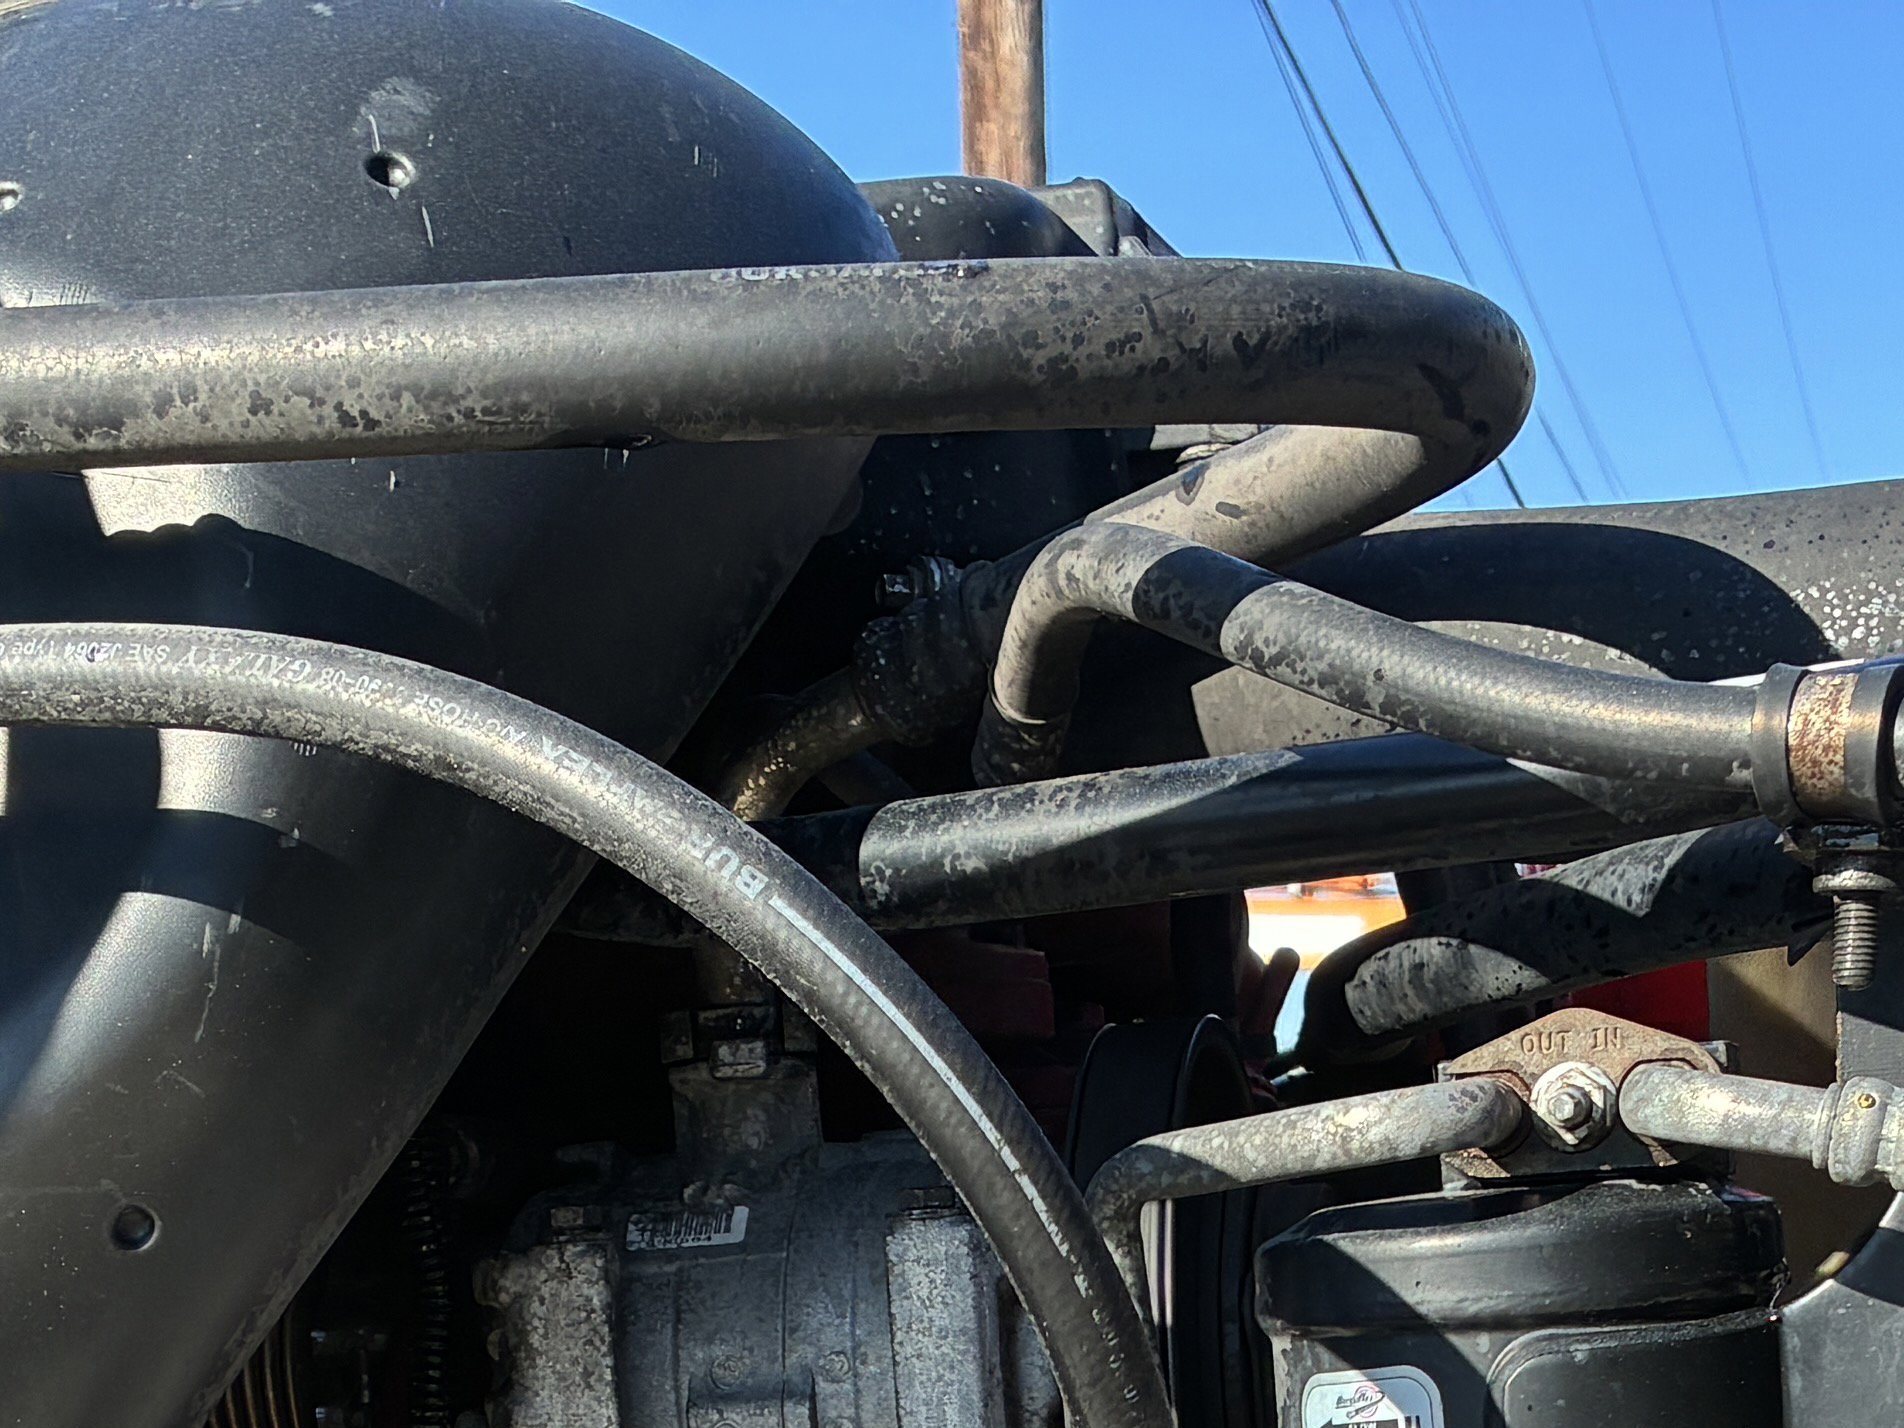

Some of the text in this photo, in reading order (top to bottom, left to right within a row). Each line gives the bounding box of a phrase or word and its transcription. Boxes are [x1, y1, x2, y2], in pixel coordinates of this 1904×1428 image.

[11, 637, 57, 662] Type
[64, 640, 124, 663] J2064
[127, 641, 171, 663] SAE
[1520, 1026, 1622, 1056] OUT IN
